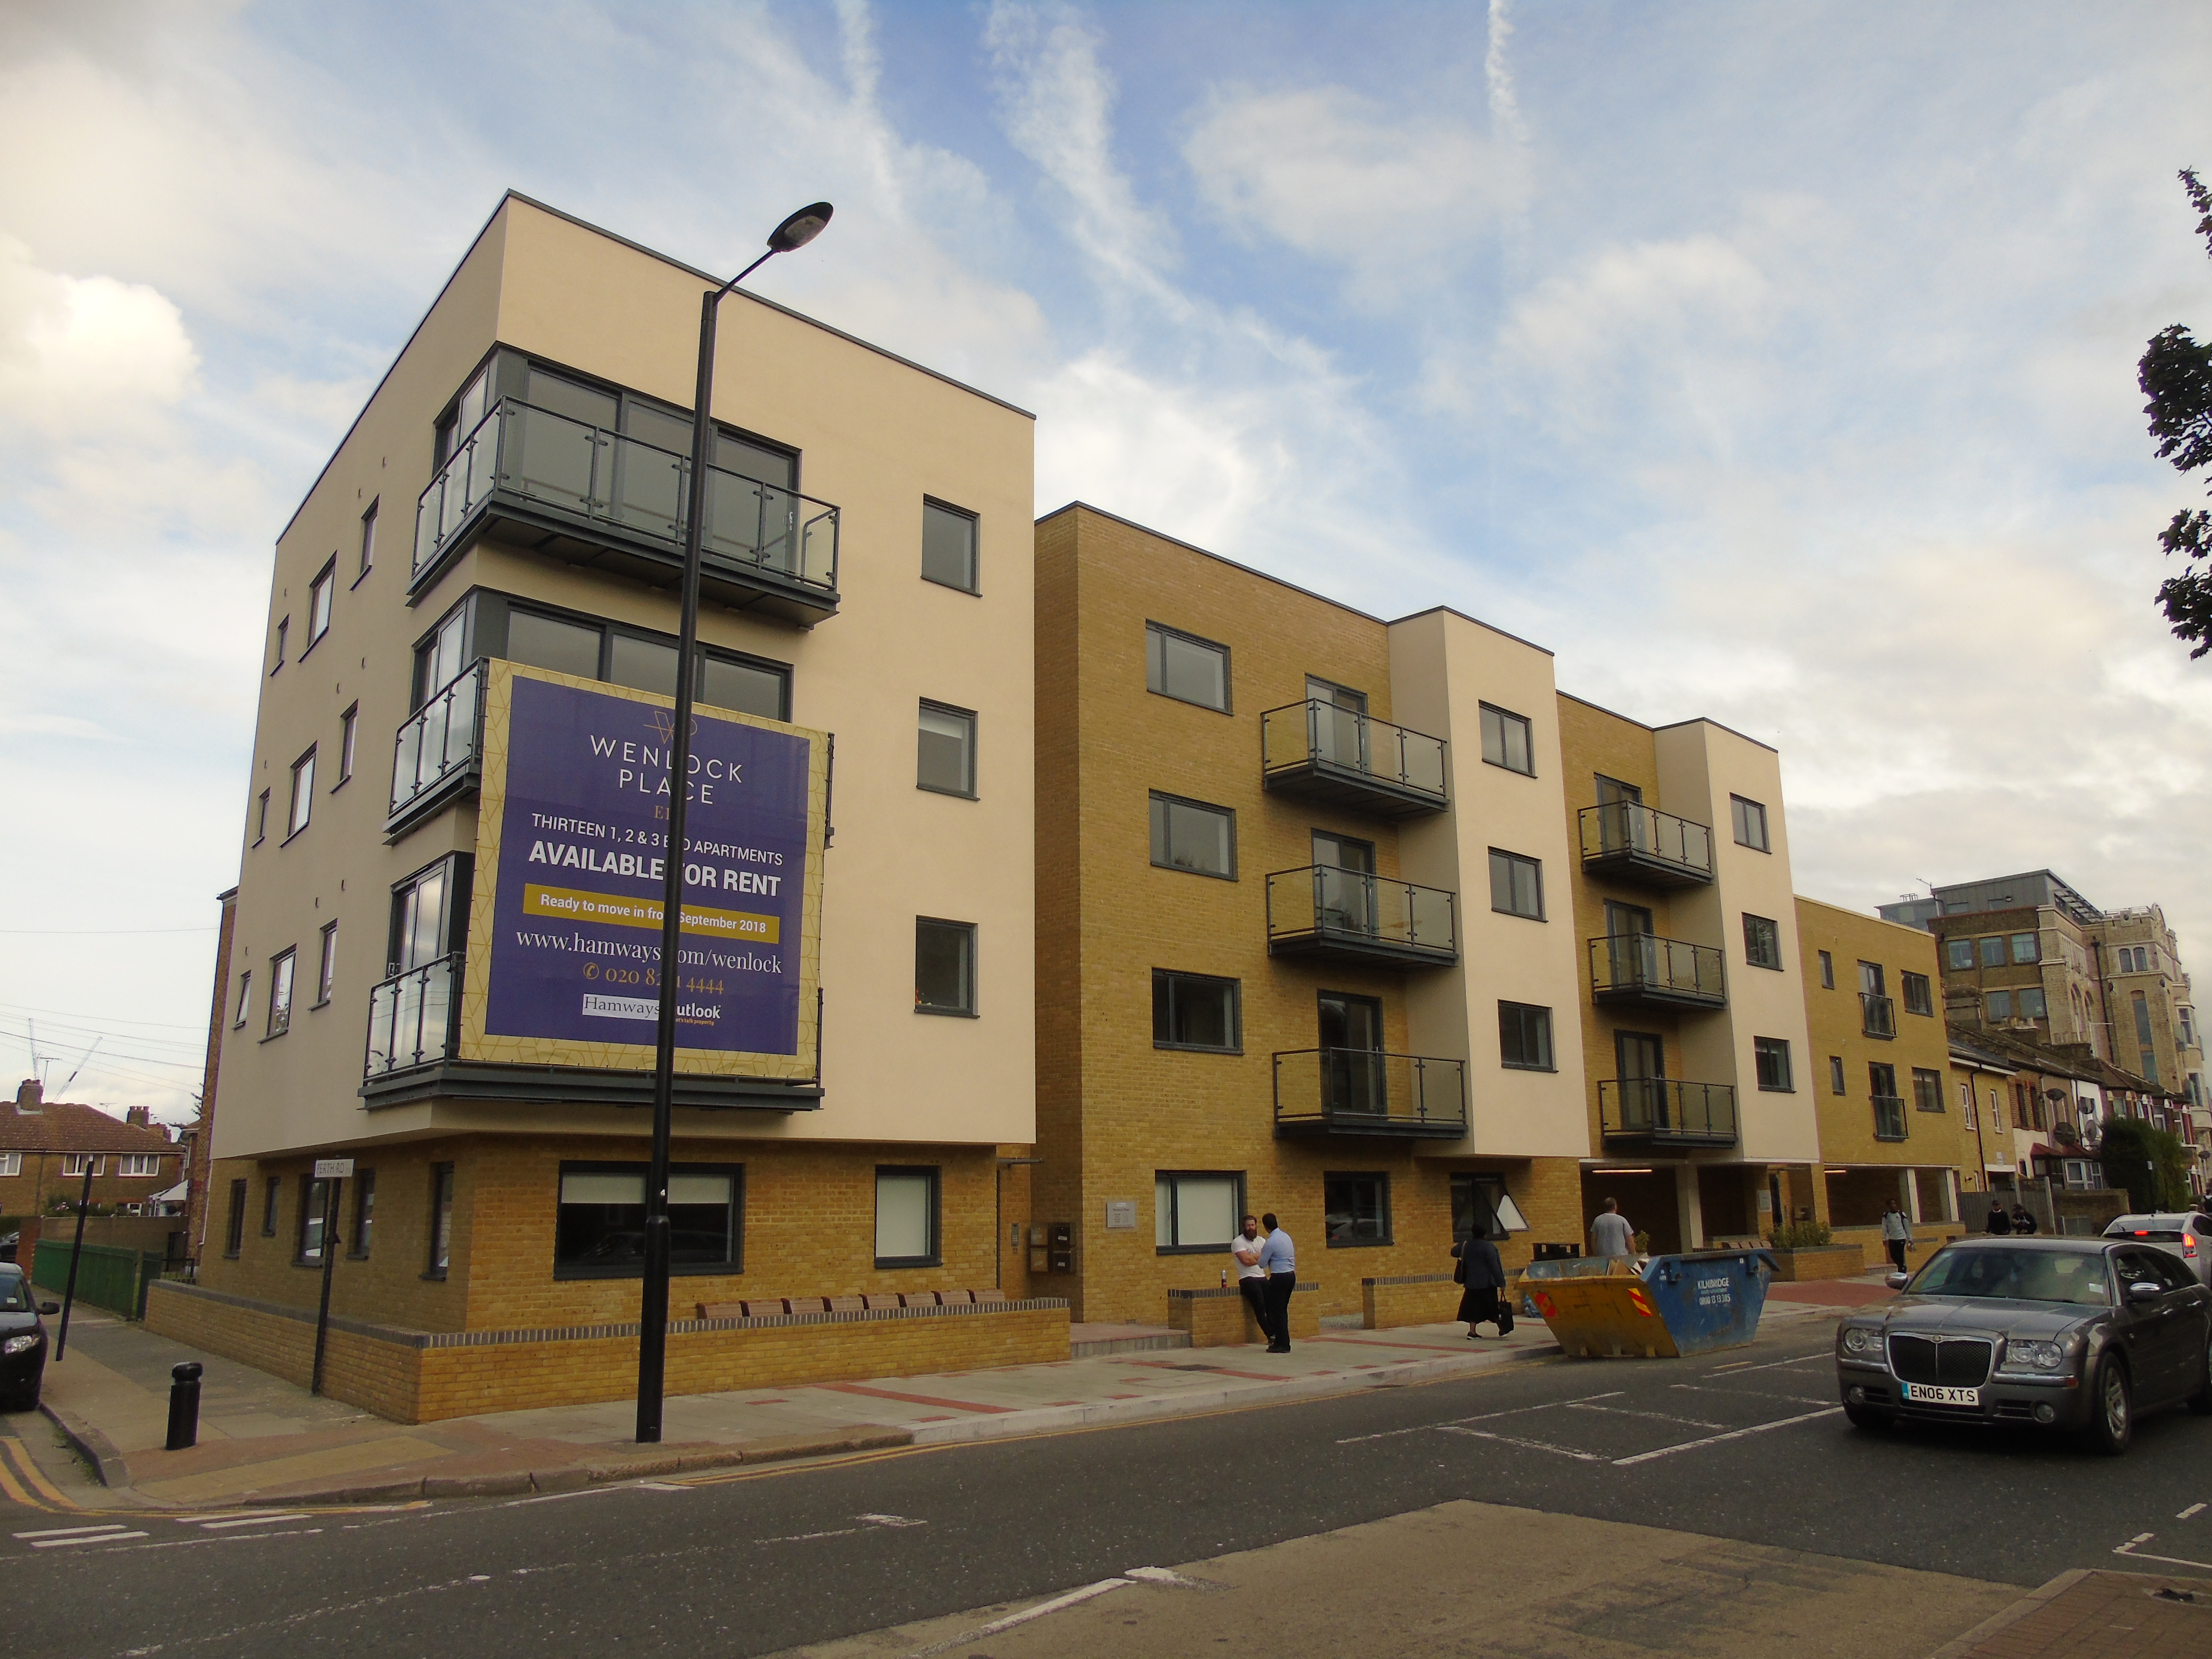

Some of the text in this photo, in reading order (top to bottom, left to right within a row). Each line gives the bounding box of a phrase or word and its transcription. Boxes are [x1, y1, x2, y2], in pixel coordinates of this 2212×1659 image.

[590, 735, 742, 783] WENLOCK
[532, 813, 606, 838] THIRTEEN
[610, 826, 622, 842] 1,
[625, 829, 634, 842] 2
[638, 831, 647, 845] &
[651, 833, 659, 846] 3
[693, 840, 783, 866] APARTMENTS
[529, 840, 781, 896] AVAILABLE OR RENT
[541, 893, 766, 933] Ready to move in fro September 2018
[516, 931, 782, 974] www.hamwaysom/wenlock
[605, 968, 639, 984] 020
[686, 977, 724, 995] 4444
[584, 996, 660, 1018] Hamways
[677, 1003, 721, 1019] utlook
[317, 1163, 335, 1173] PERTH
[337, 1162, 344, 1173] RD
[1697, 1278, 1729, 1289] KILNBRIDGE
[1911, 1386, 1975, 1402] EN06 XTS
